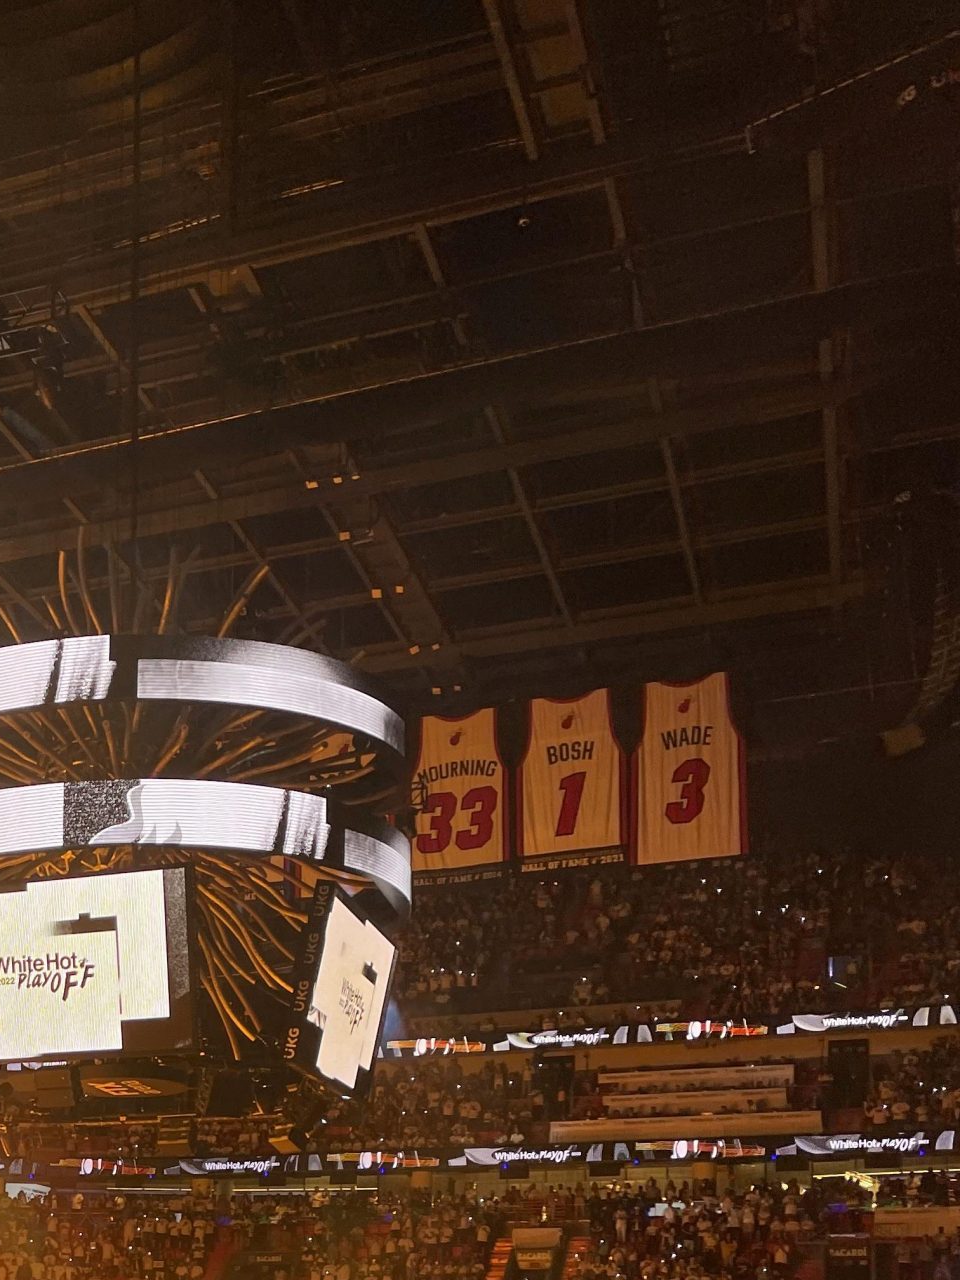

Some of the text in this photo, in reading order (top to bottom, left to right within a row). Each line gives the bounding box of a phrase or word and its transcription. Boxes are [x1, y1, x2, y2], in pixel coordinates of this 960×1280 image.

[547, 741, 595, 765] BOSH
[661, 726, 713, 750] WADE
[418, 760, 498, 783] MOURNING
[665, 758, 711, 824] 3
[416, 785, 498, 854] 33
[555, 771, 587, 837] 1
